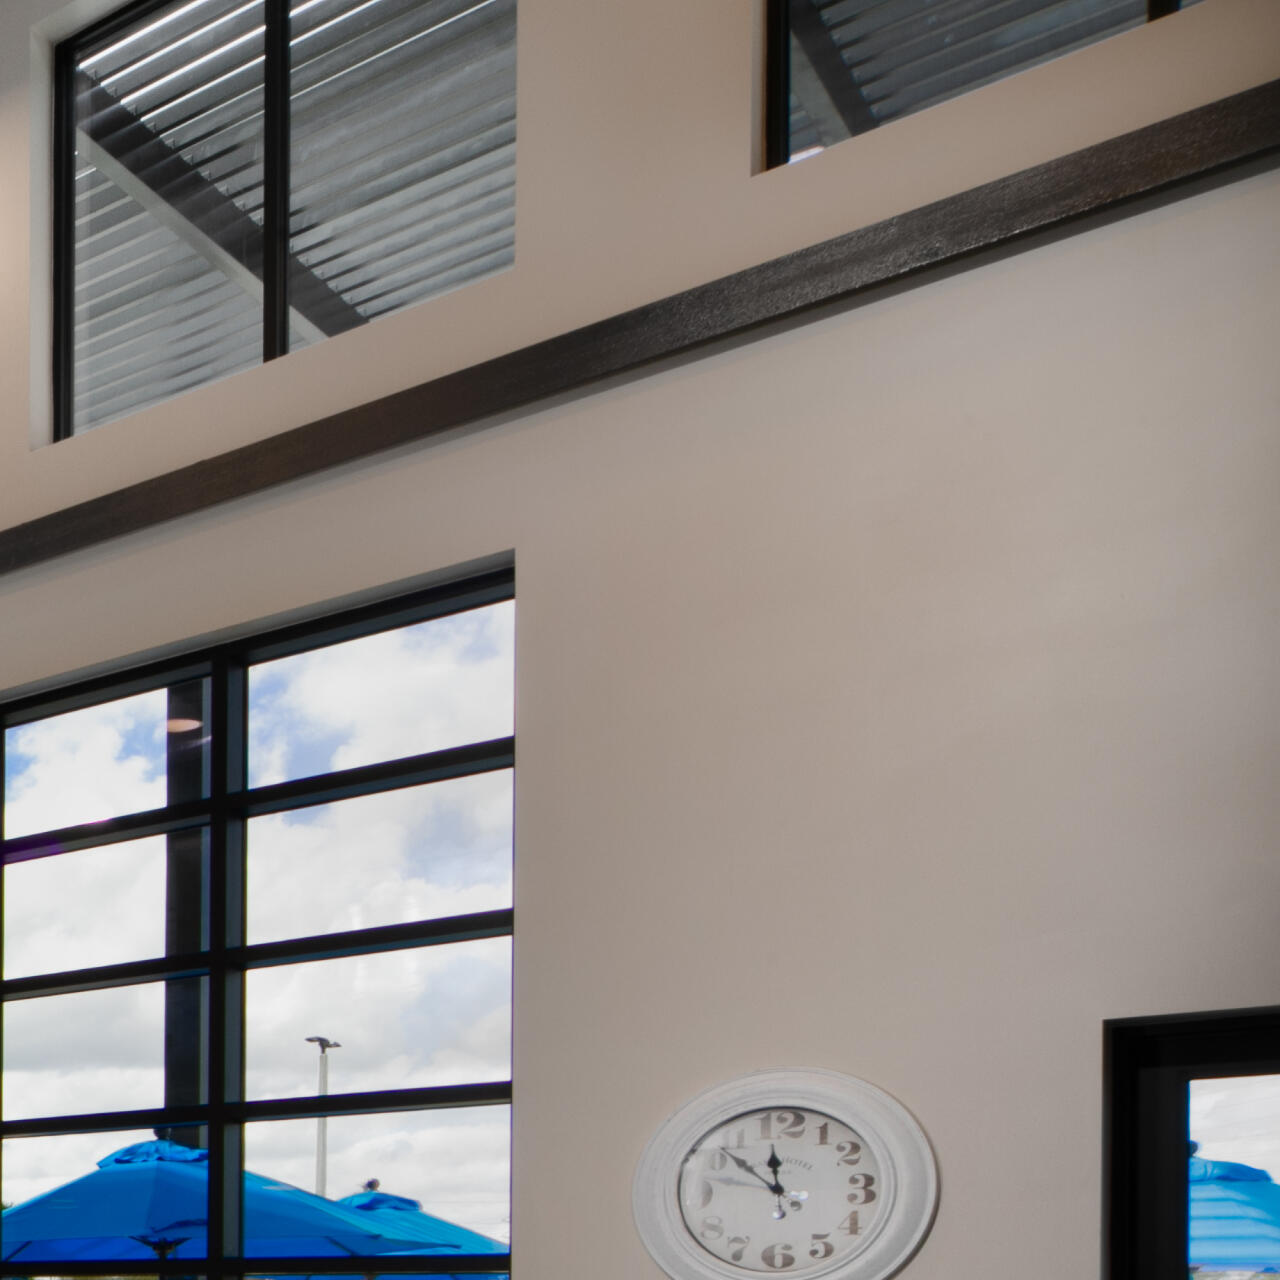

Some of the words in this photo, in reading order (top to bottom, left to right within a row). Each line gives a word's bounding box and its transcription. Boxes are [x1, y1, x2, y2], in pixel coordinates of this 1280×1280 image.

[756, 1110, 806, 1140] 12
[816, 1122, 833, 1145] 1
[836, 1141, 862, 1166] 2
[847, 1173, 876, 1205] 3
[700, 1216, 724, 1240] 8
[838, 1210, 862, 1235] 4
[727, 1235, 750, 1262] 7
[761, 1243, 795, 1269] 6
[809, 1233, 834, 1259] 5
